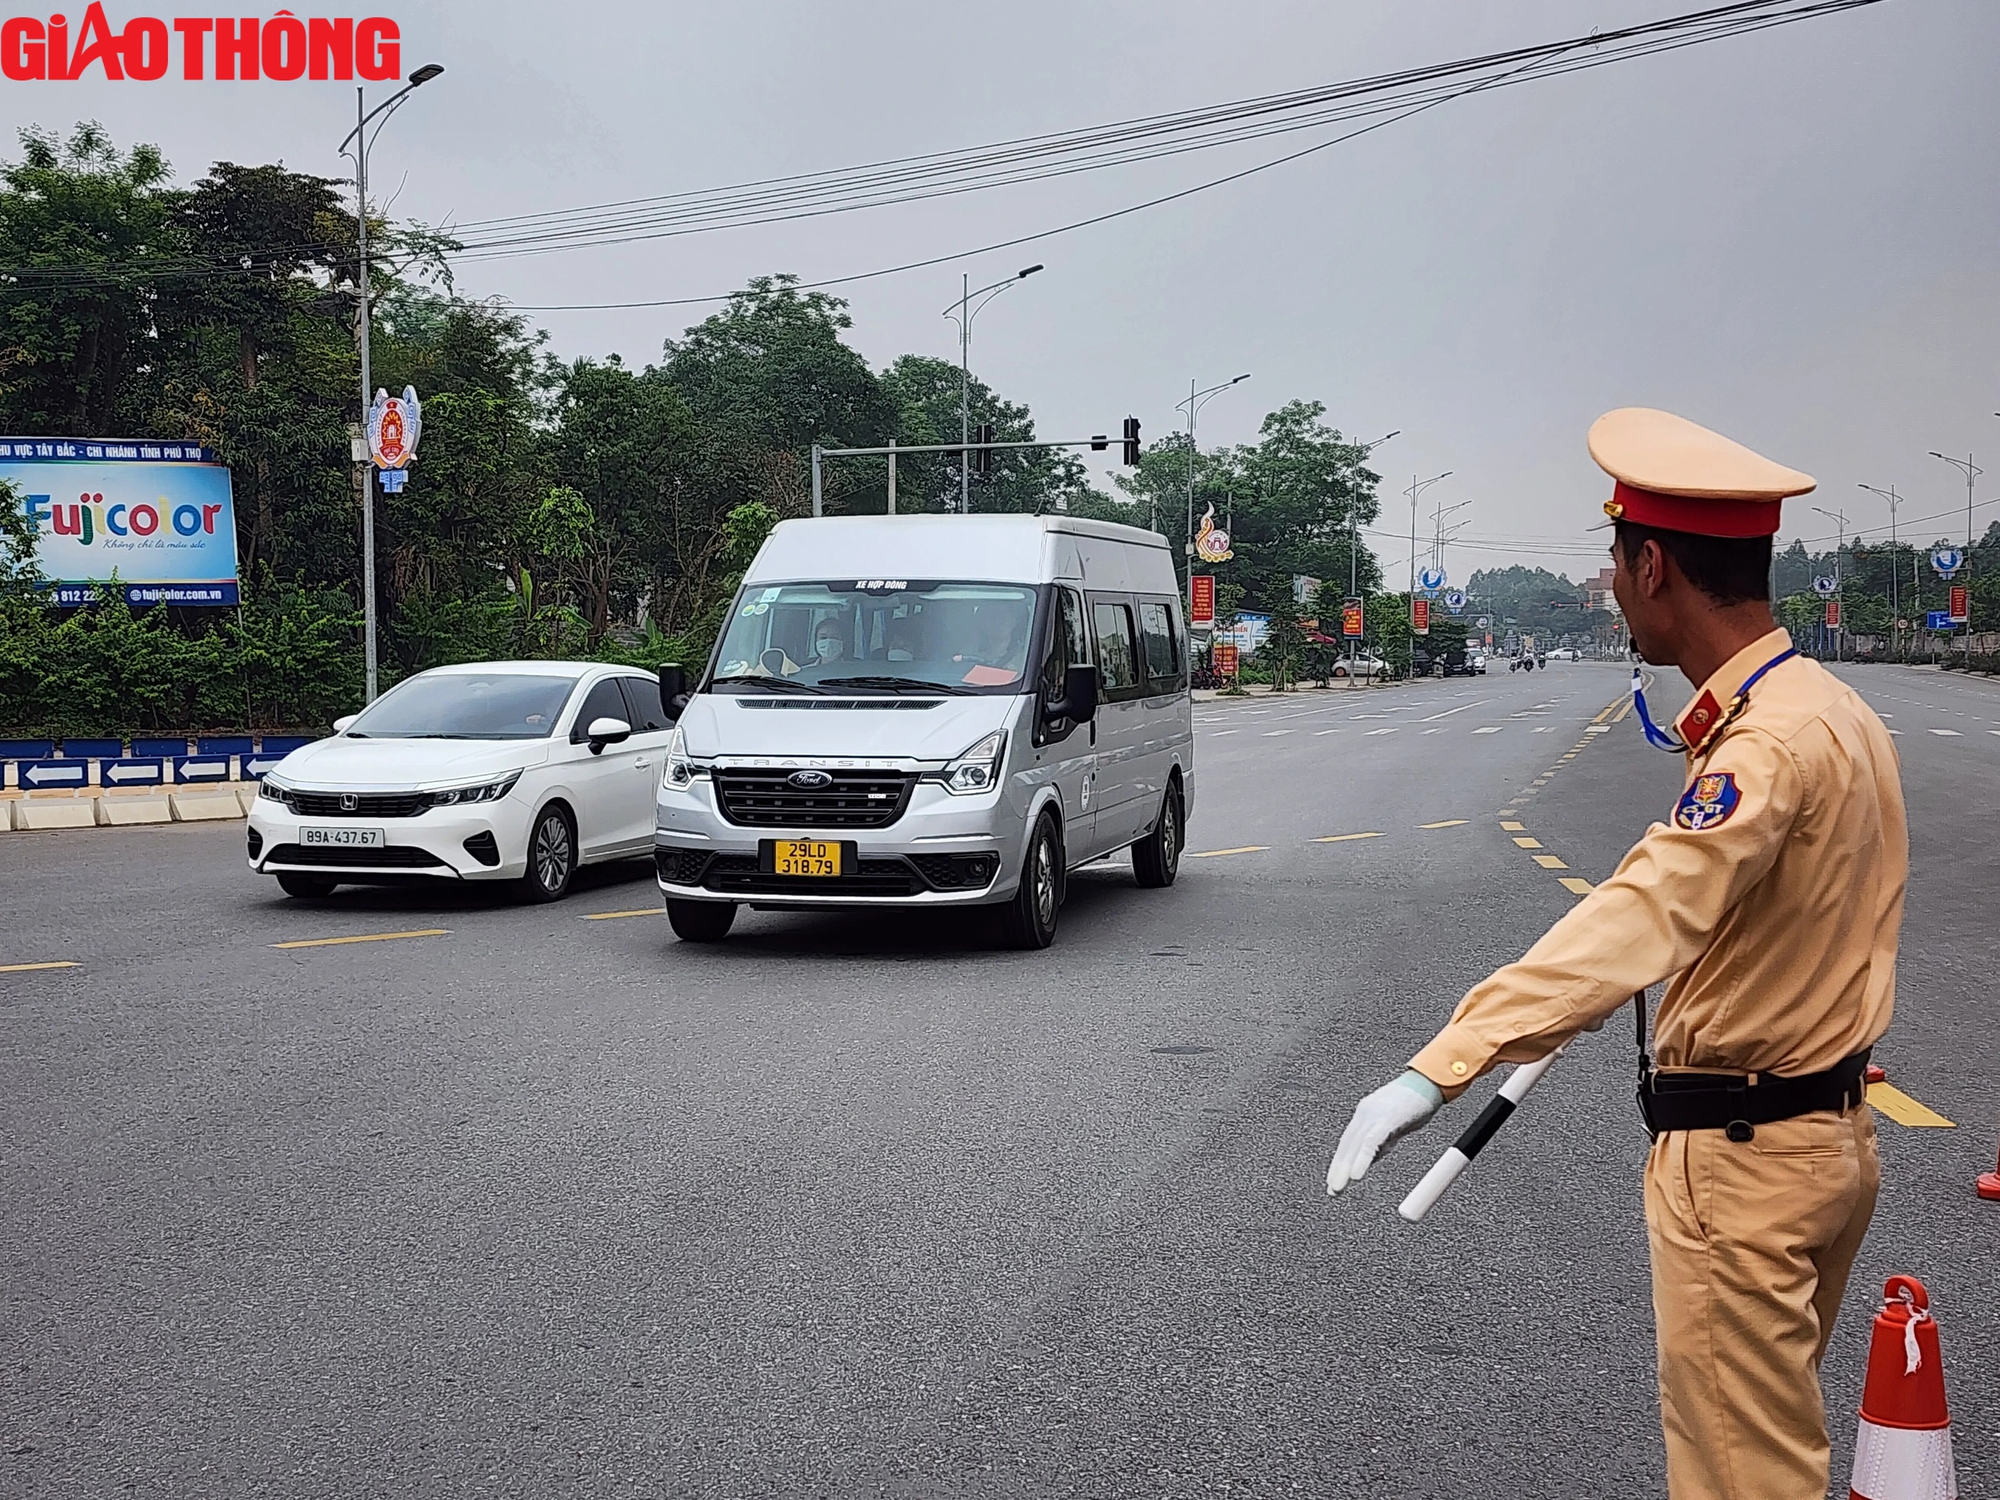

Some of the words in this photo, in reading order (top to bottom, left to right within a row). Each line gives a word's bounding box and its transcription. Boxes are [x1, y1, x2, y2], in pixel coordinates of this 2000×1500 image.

[14, 444, 33, 459] VỰC
[36, 443, 53, 457] TÂY
[57, 441, 76, 457] BẮC
[87, 446, 103, 458] CHI
[105, 445, 138, 458] NHÁNH
[140, 444, 162, 458] TỈNH
[163, 445, 182, 459] PHÚ
[184, 447, 202, 461] THỌ
[25, 492, 223, 546] Fujicolor
[103, 539, 135, 551] Không
[137, 539, 153, 549] chỉ
[155, 539, 165, 549] là
[190, 539, 207, 549] sắc
[855, 580, 868, 589] XE
[867, 580, 885, 590] HỢP
[61, 590, 82, 602] 812
[728, 758, 899, 768] TRANSIT
[797, 773, 822, 785] Ford
[1704, 803, 1725, 814] GT
[306, 830, 377, 844] 89A-437.67
[788, 843, 827, 858] 29LD
[782, 859, 833, 875] 318.79
